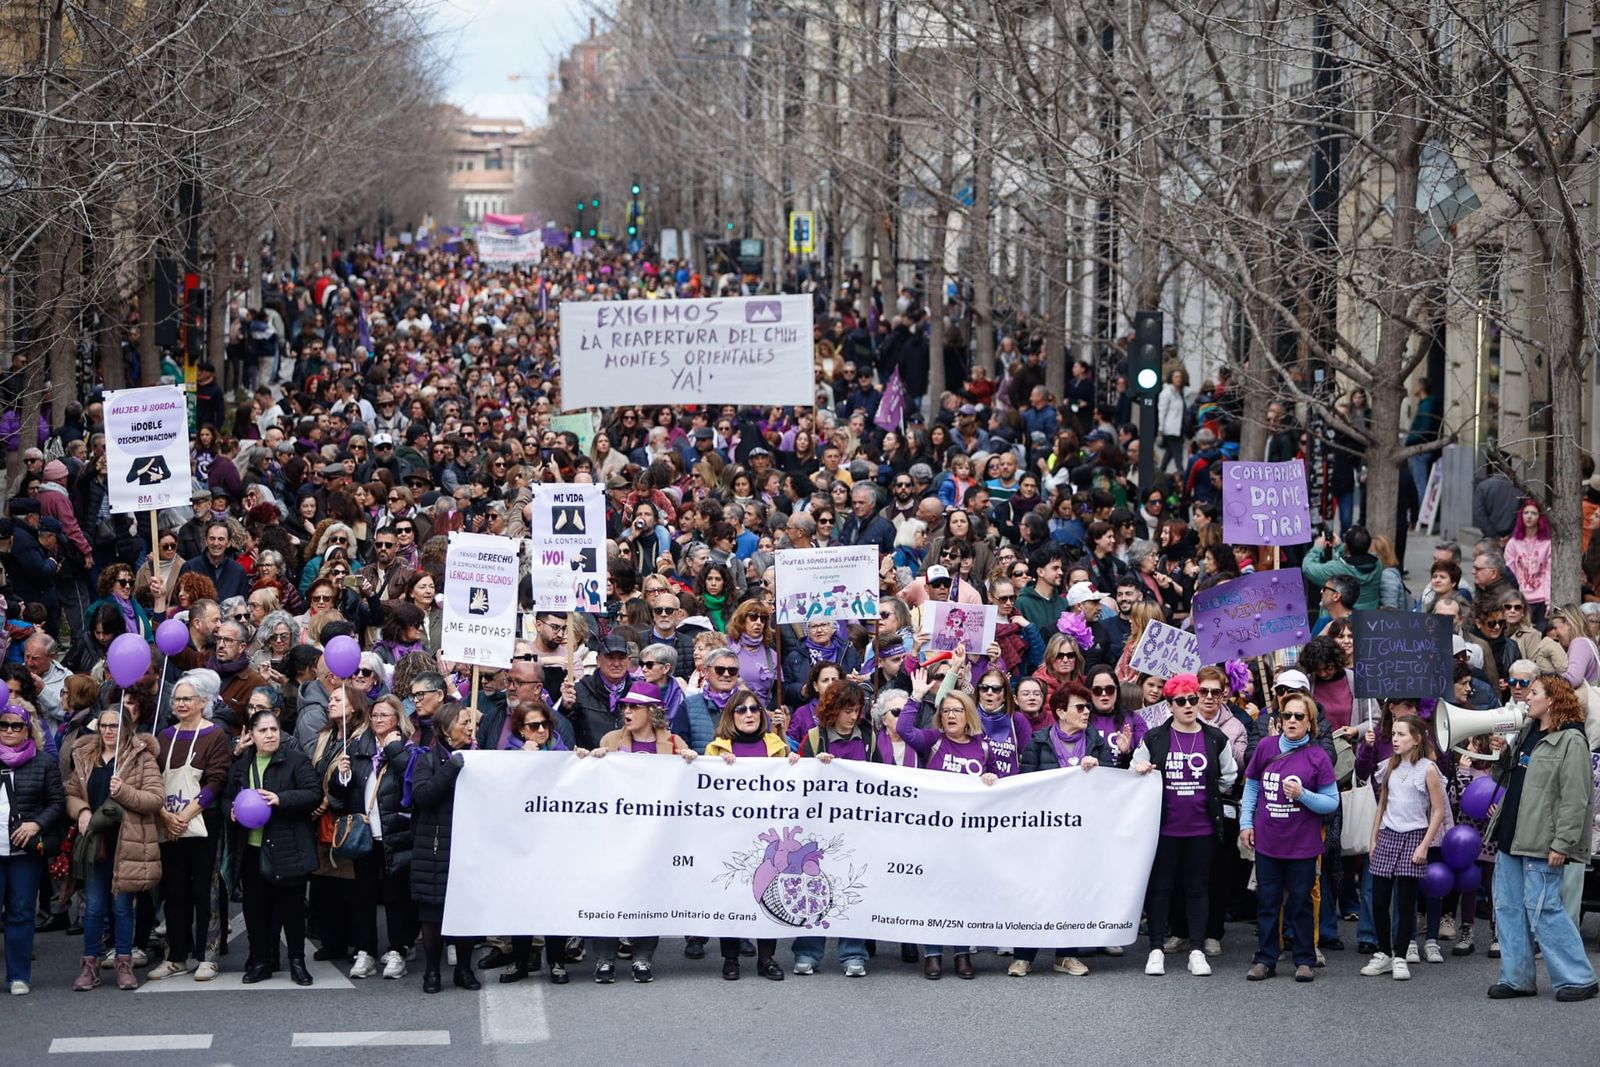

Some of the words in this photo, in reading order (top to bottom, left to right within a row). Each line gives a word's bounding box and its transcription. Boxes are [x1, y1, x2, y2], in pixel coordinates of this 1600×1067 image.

[597, 301, 723, 328] EXIGIMOS
[580, 333, 602, 350] LA
[611, 328, 718, 349] REAPERTURA
[728, 327, 758, 344] DEL
[604, 350, 670, 369] MONTES
[684, 348, 776, 366] ORIENTALES
[671, 367, 702, 393] YA!
[112, 406, 141, 415] MUJER
[131, 420, 163, 431] ¡¡DOBLE
[138, 495, 152, 504] 8M
[553, 494, 564, 502] MI
[565, 494, 584, 502] VIDA
[478, 552, 513, 564] DERECHO
[542, 550, 564, 566] ¡YO!
[807, 557, 828, 565] SOMOS
[449, 570, 474, 582] LENGUA
[476, 572, 485, 583] DE
[444, 622, 464, 633] ¿ME
[468, 623, 512, 638] APOYAS?
[1367, 619, 1401, 631] VIVA
[1165, 629, 1183, 646] DE
[464, 646, 476, 657] 8M
[1161, 647, 1179, 664] DÍA
[1367, 676, 1447, 694] LIBERTAD
[1165, 760, 1184, 770] PASO
[697, 773, 796, 792] Derechos
[803, 777, 849, 797] para
[855, 780, 919, 799] todas:
[524, 796, 608, 815] alianzas
[615, 798, 725, 818] feministas
[731, 803, 800, 820] contra
[806, 802, 823, 819] el
[829, 804, 954, 828] patriarcado
[961, 811, 1083, 833] imperialista
[672, 855, 694, 867] 8M
[886, 862, 924, 876] 2026
[578, 910, 615, 922] Espacio
[617, 910, 669, 921] Feminismo
[671, 909, 711, 921] Unitario
[712, 911, 725, 921] de
[728, 911, 757, 922] Graná
[871, 914, 925, 927] Plataforma
[927, 917, 964, 929] 8M/25N
[967, 920, 993, 929] contra
[995, 920, 1003, 930] la
[1004, 920, 1043, 930] Violencia
[1043, 921, 1055, 930] de
[1055, 920, 1086, 931] Género
[1086, 921, 1098, 930] de
[1098, 919, 1134, 930] Granada
